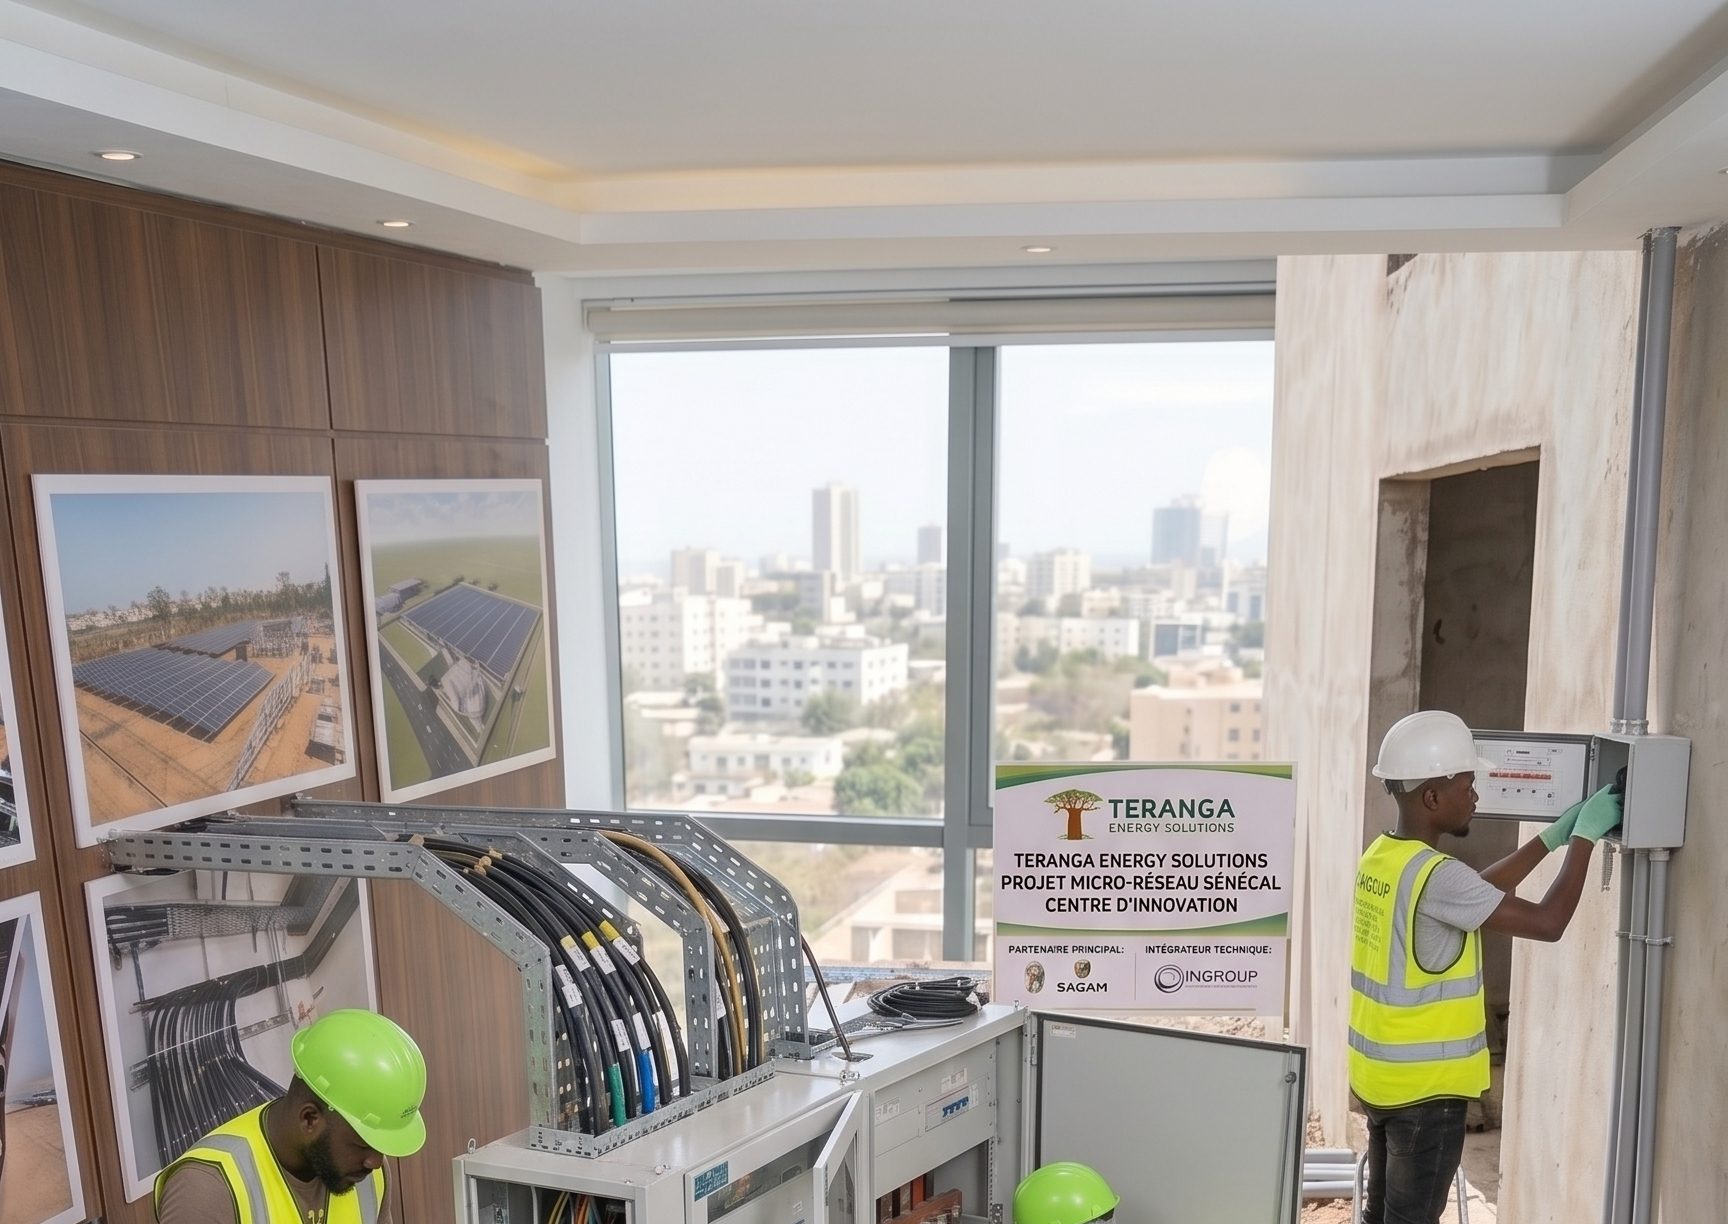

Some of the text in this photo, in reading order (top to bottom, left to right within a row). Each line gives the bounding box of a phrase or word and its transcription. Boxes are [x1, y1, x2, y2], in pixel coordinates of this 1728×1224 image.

[1108, 798, 1236, 819] TERANGA
[1109, 823, 1235, 833] ENERGY SOLUTIONS
[1014, 853, 1268, 868] TERANGA ENERGY SOLUTIONS
[1001, 871, 1282, 891] PROJET MICRO-RÉSEAU SÉNÉCAL
[1045, 897, 1238, 913] CENTRE D'INNOVATION
[1008, 945, 1125, 954] PARTENAIRE PRINCIPAL:
[1145, 943, 1272, 956] INTÉGRATEUR TECHNIQUE:
[1185, 970, 1258, 983] INGROUP
[1057, 982, 1108, 993] SAGAM
